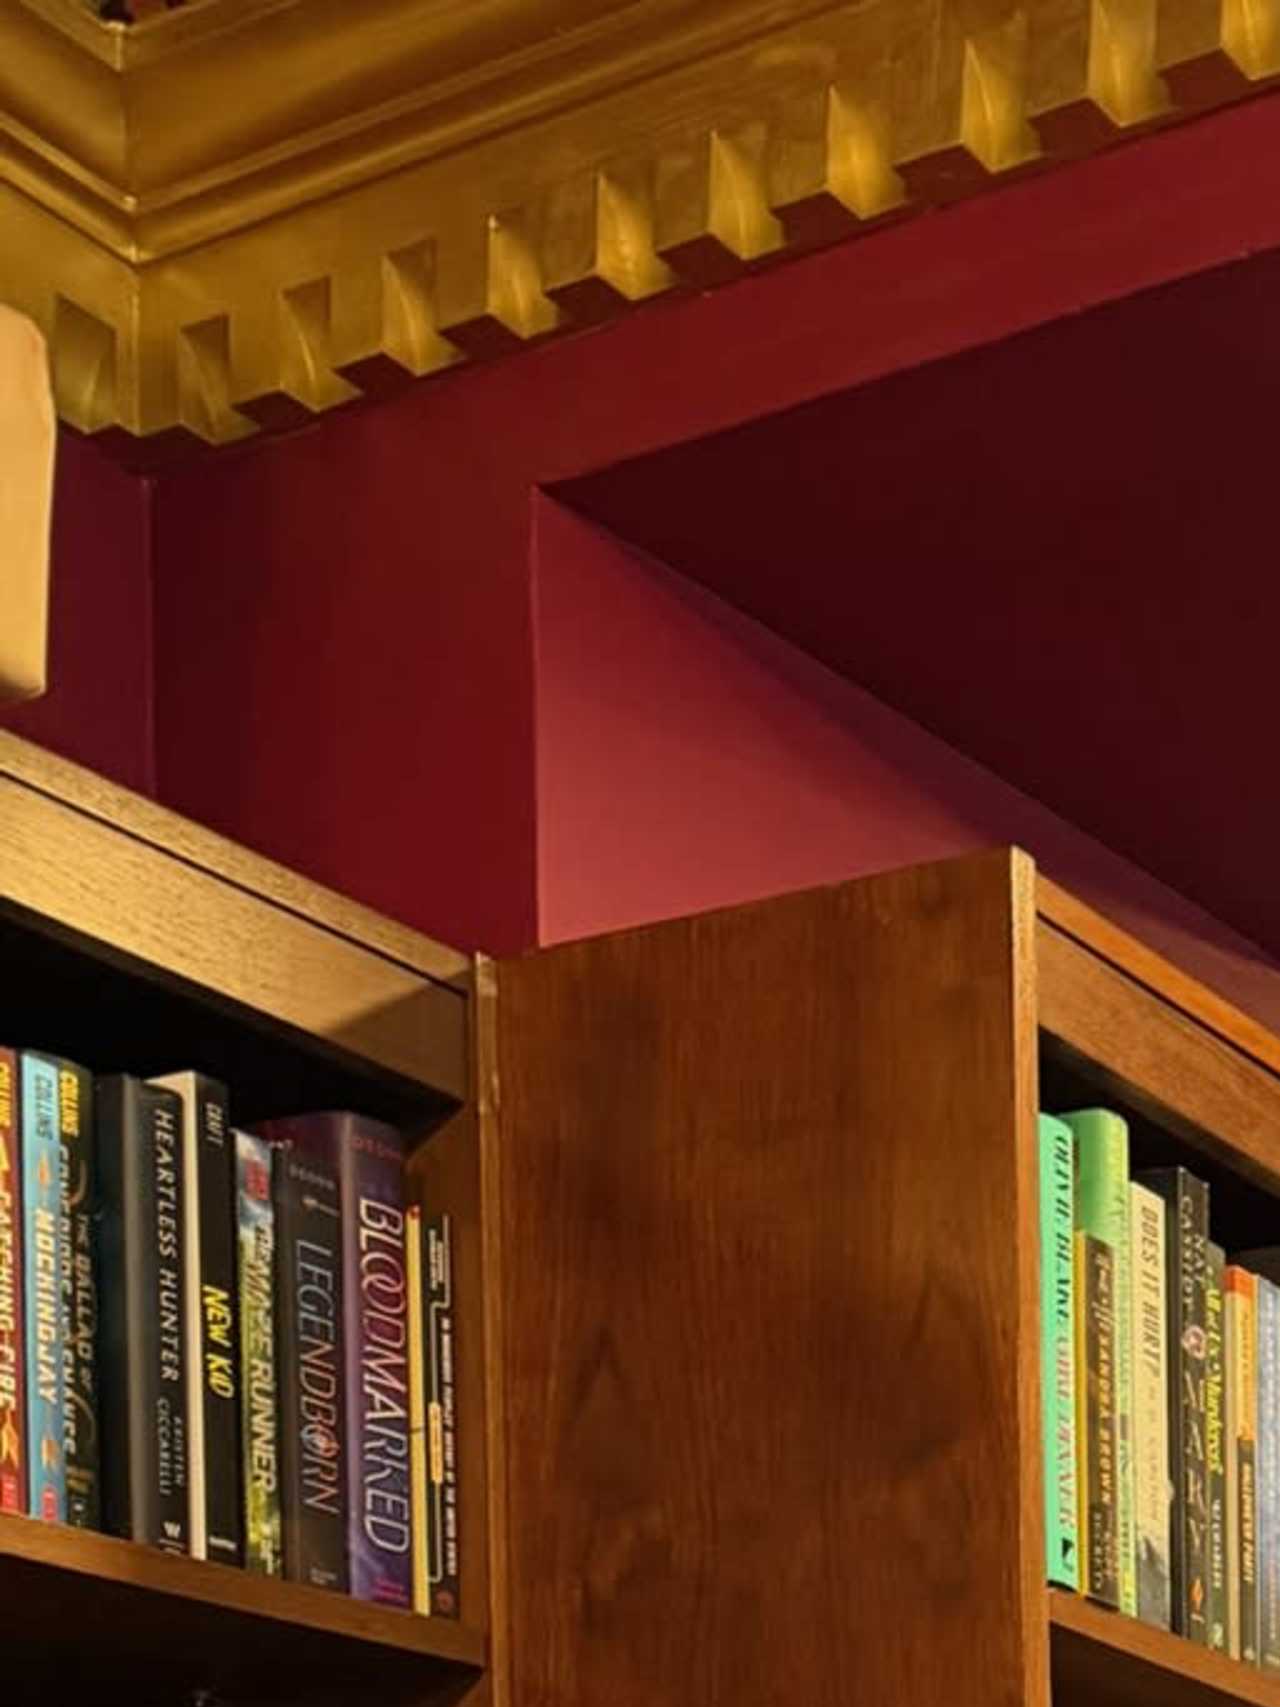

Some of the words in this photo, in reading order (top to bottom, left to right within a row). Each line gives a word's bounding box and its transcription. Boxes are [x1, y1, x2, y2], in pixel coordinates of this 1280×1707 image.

[154, 1108, 178, 1260] HEARTLESS
[1141, 1204, 1161, 1269] DOES
[35, 1207, 58, 1404] MOCKINGJAY
[159, 1267, 179, 1383] HUNTER
[202, 1284, 233, 1348] NEW
[1143, 1271, 1162, 1292] IT
[207, 1352, 235, 1400] KID
[249, 1358, 277, 1493] RUNNER
[296, 1240, 340, 1516] LEGENDBORN
[359, 1196, 410, 1555] BLOODMARKED
